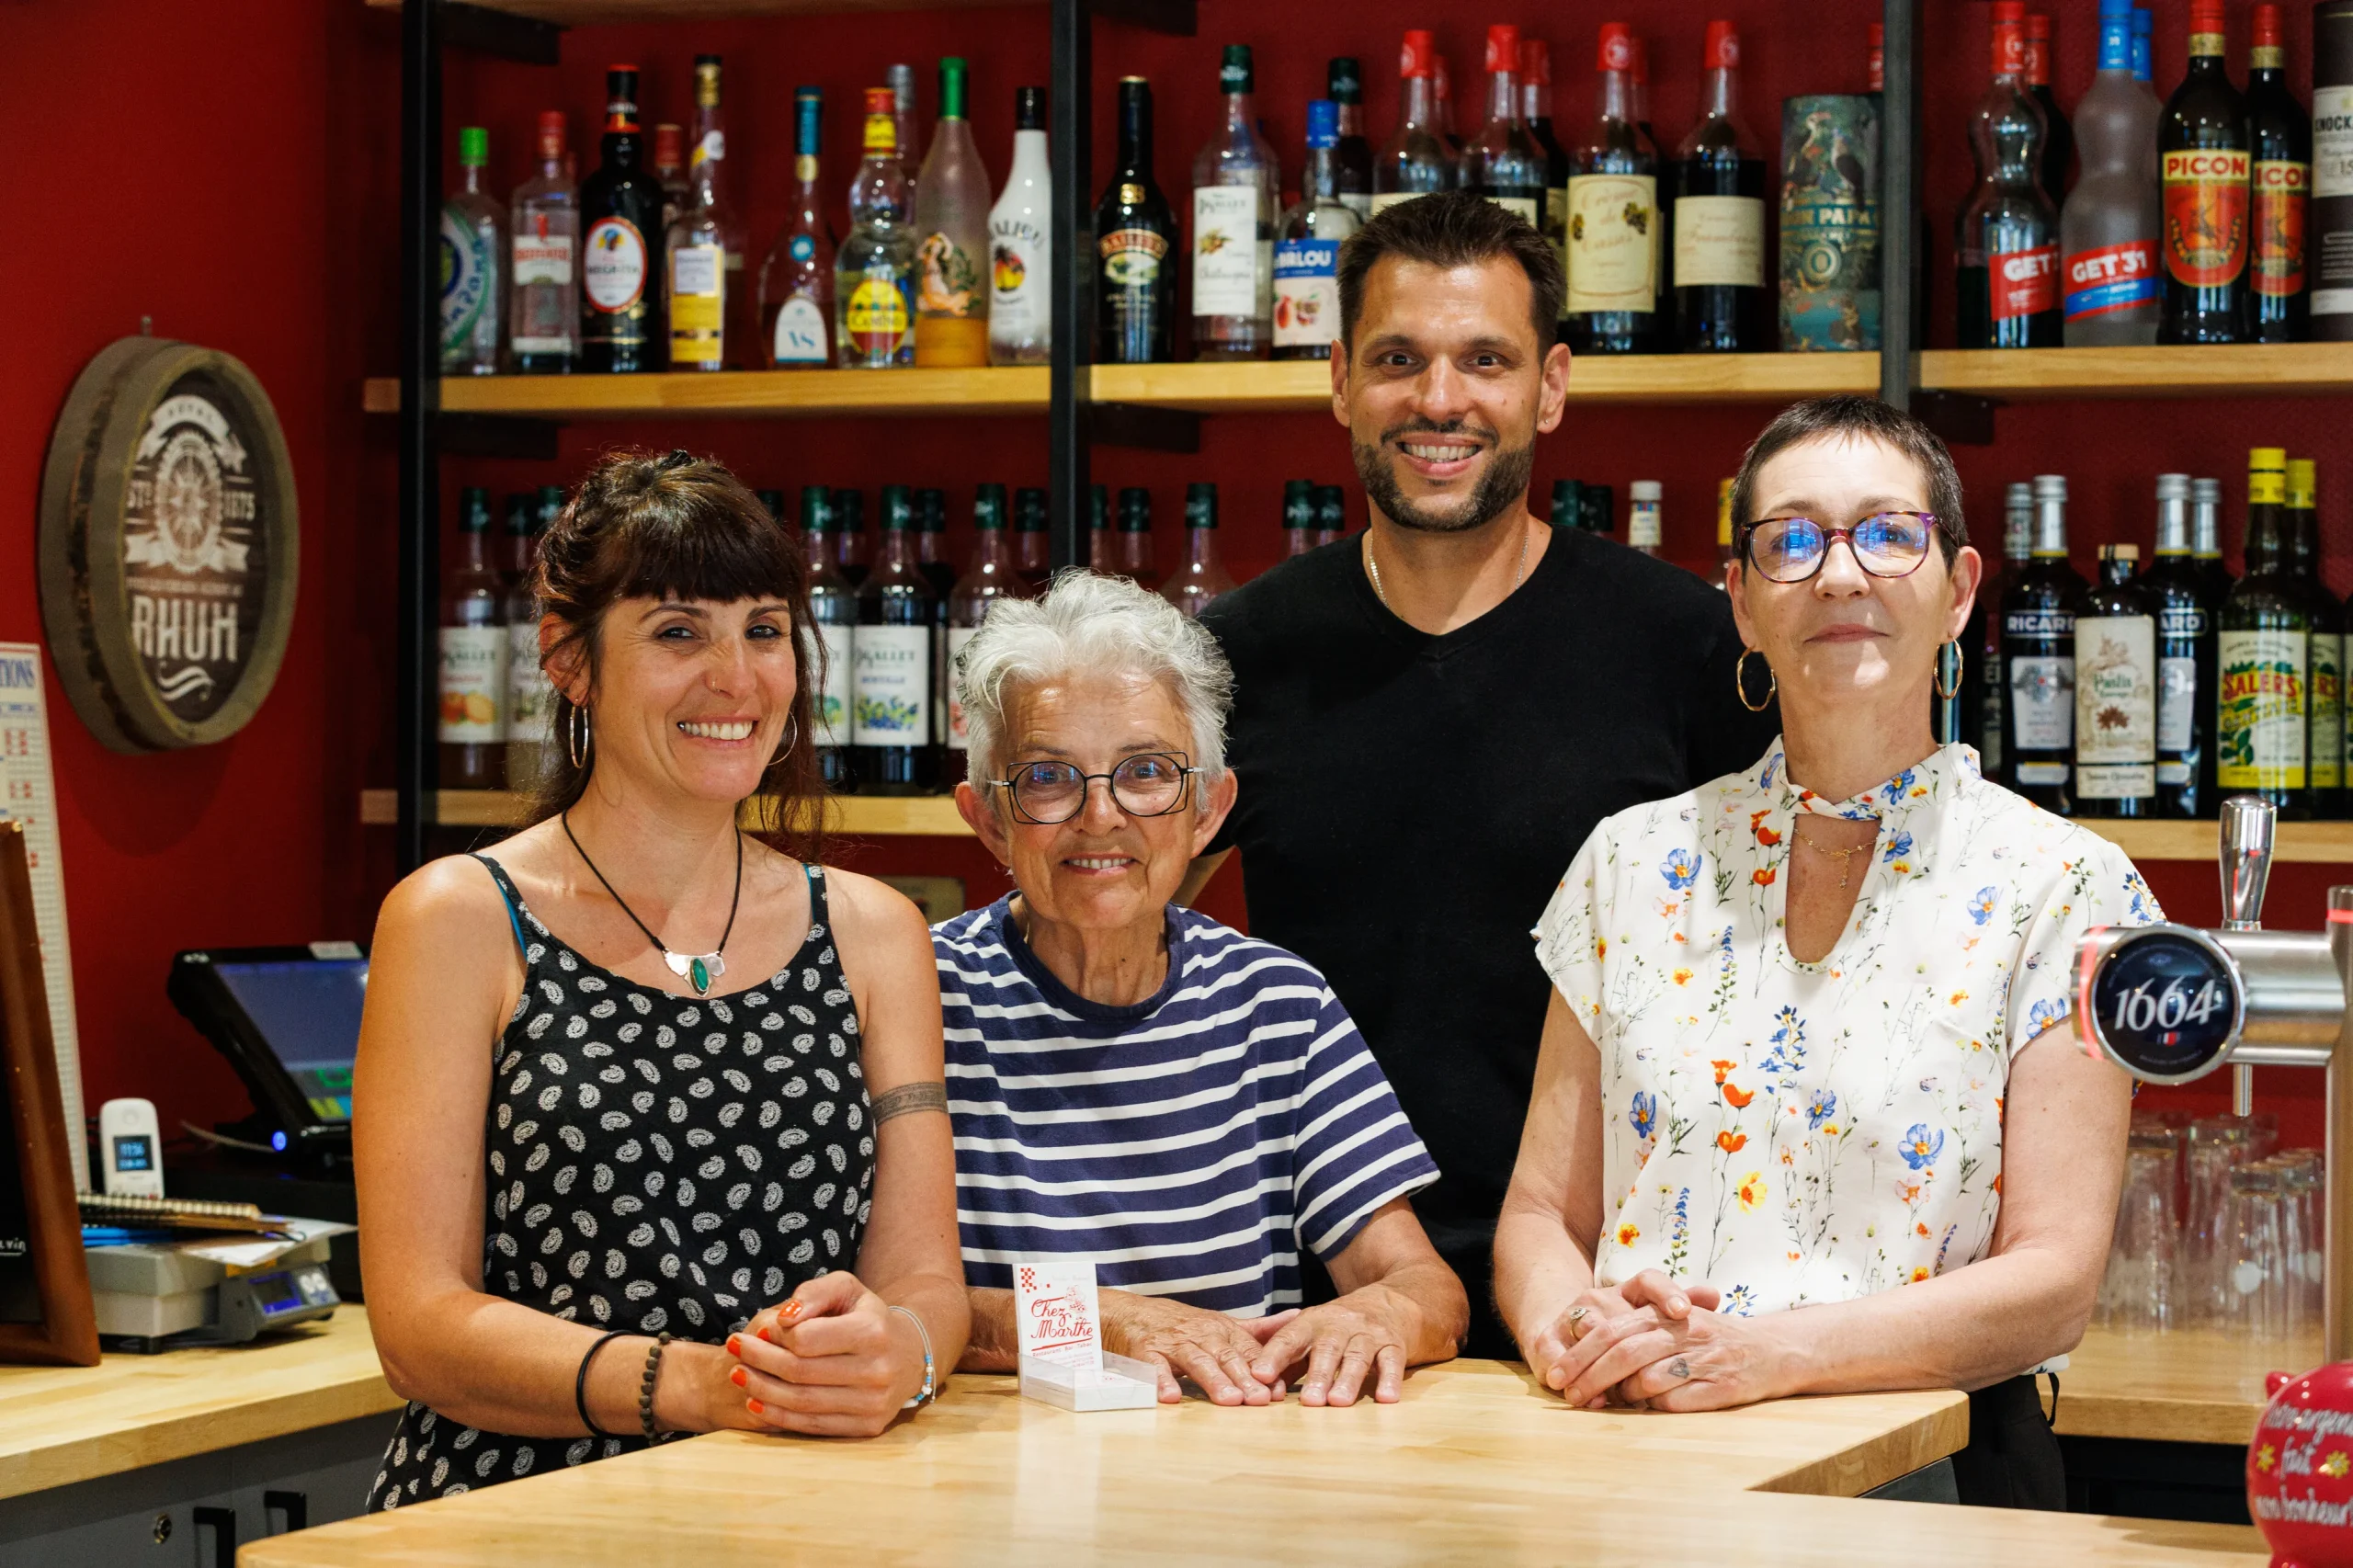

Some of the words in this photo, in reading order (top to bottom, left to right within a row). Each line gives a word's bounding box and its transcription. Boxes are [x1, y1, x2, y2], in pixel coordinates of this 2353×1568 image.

[2167, 156, 2245, 176] PICON
[2003, 253, 2052, 282] GET
[2072, 254, 2120, 283] GET
[2120, 250, 2147, 274] 31
[2222, 672, 2297, 701] SALERS
[2114, 973, 2222, 1032] 1664
[1030, 1296, 1073, 1328] Chez
[1030, 1317, 1093, 1339] Marthe
[2296, 1408, 2353, 1446] argen
